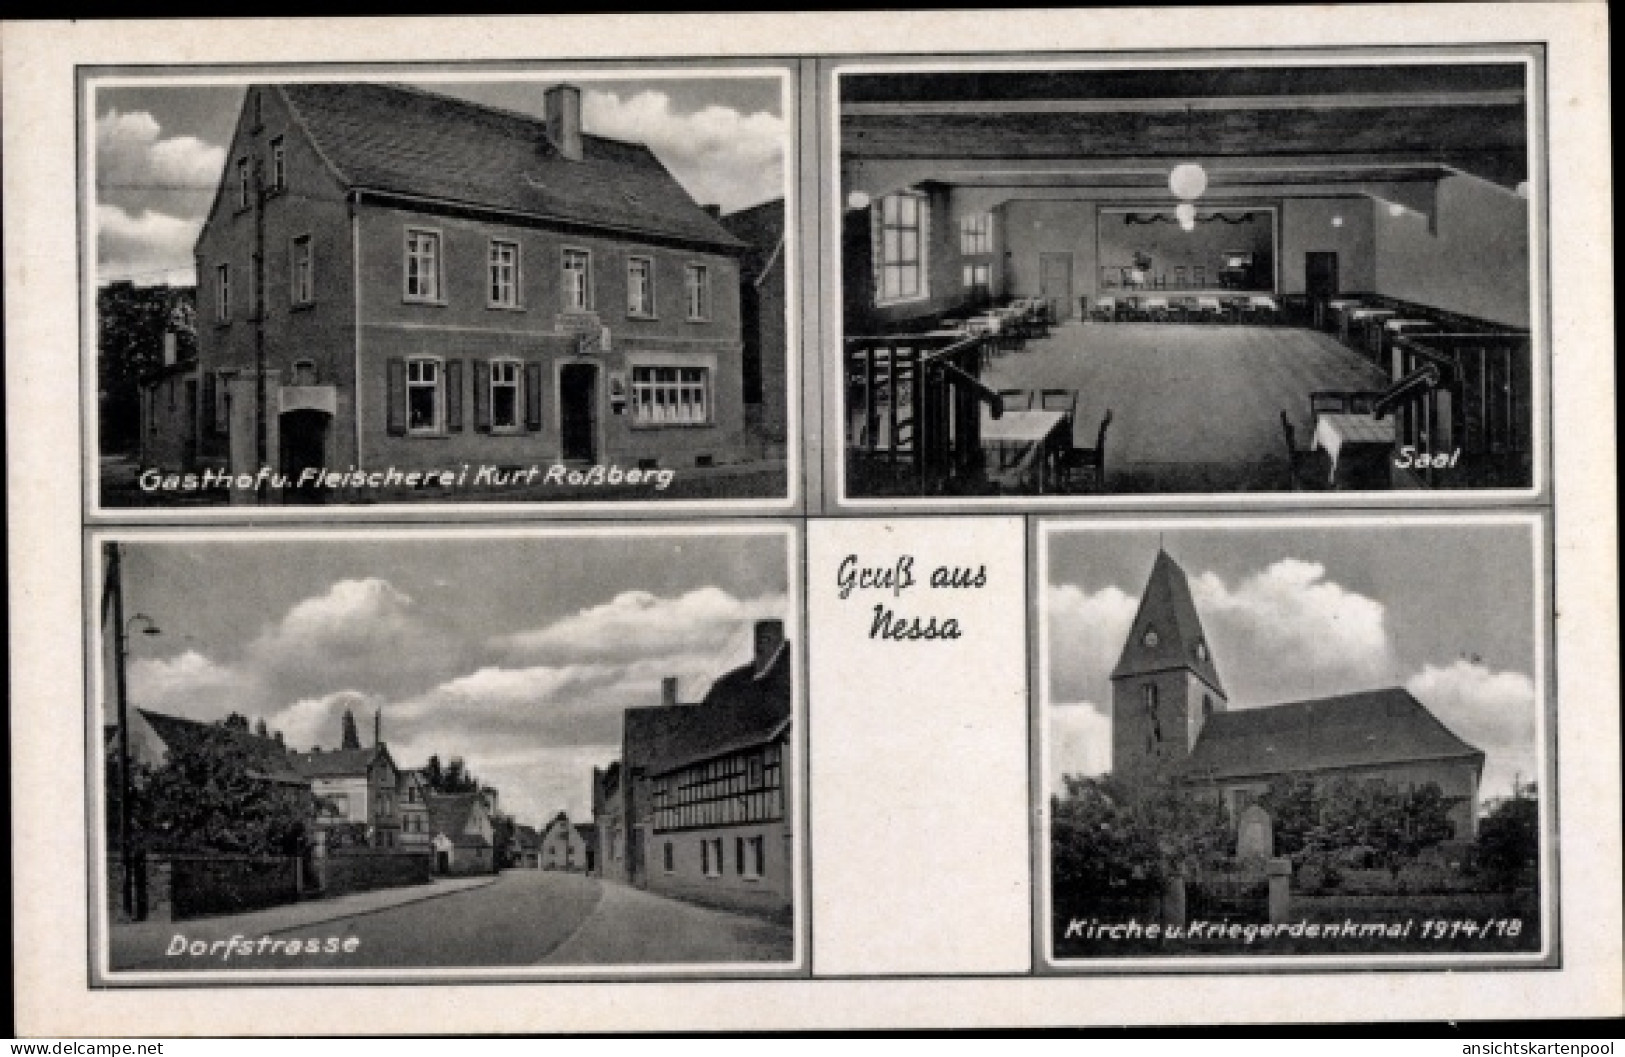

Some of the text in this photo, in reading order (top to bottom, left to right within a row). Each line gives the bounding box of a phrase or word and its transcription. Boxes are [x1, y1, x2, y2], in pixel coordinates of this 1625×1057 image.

[837, 554, 987, 600] Gruß aus
[868, 602, 963, 641] Nessa
